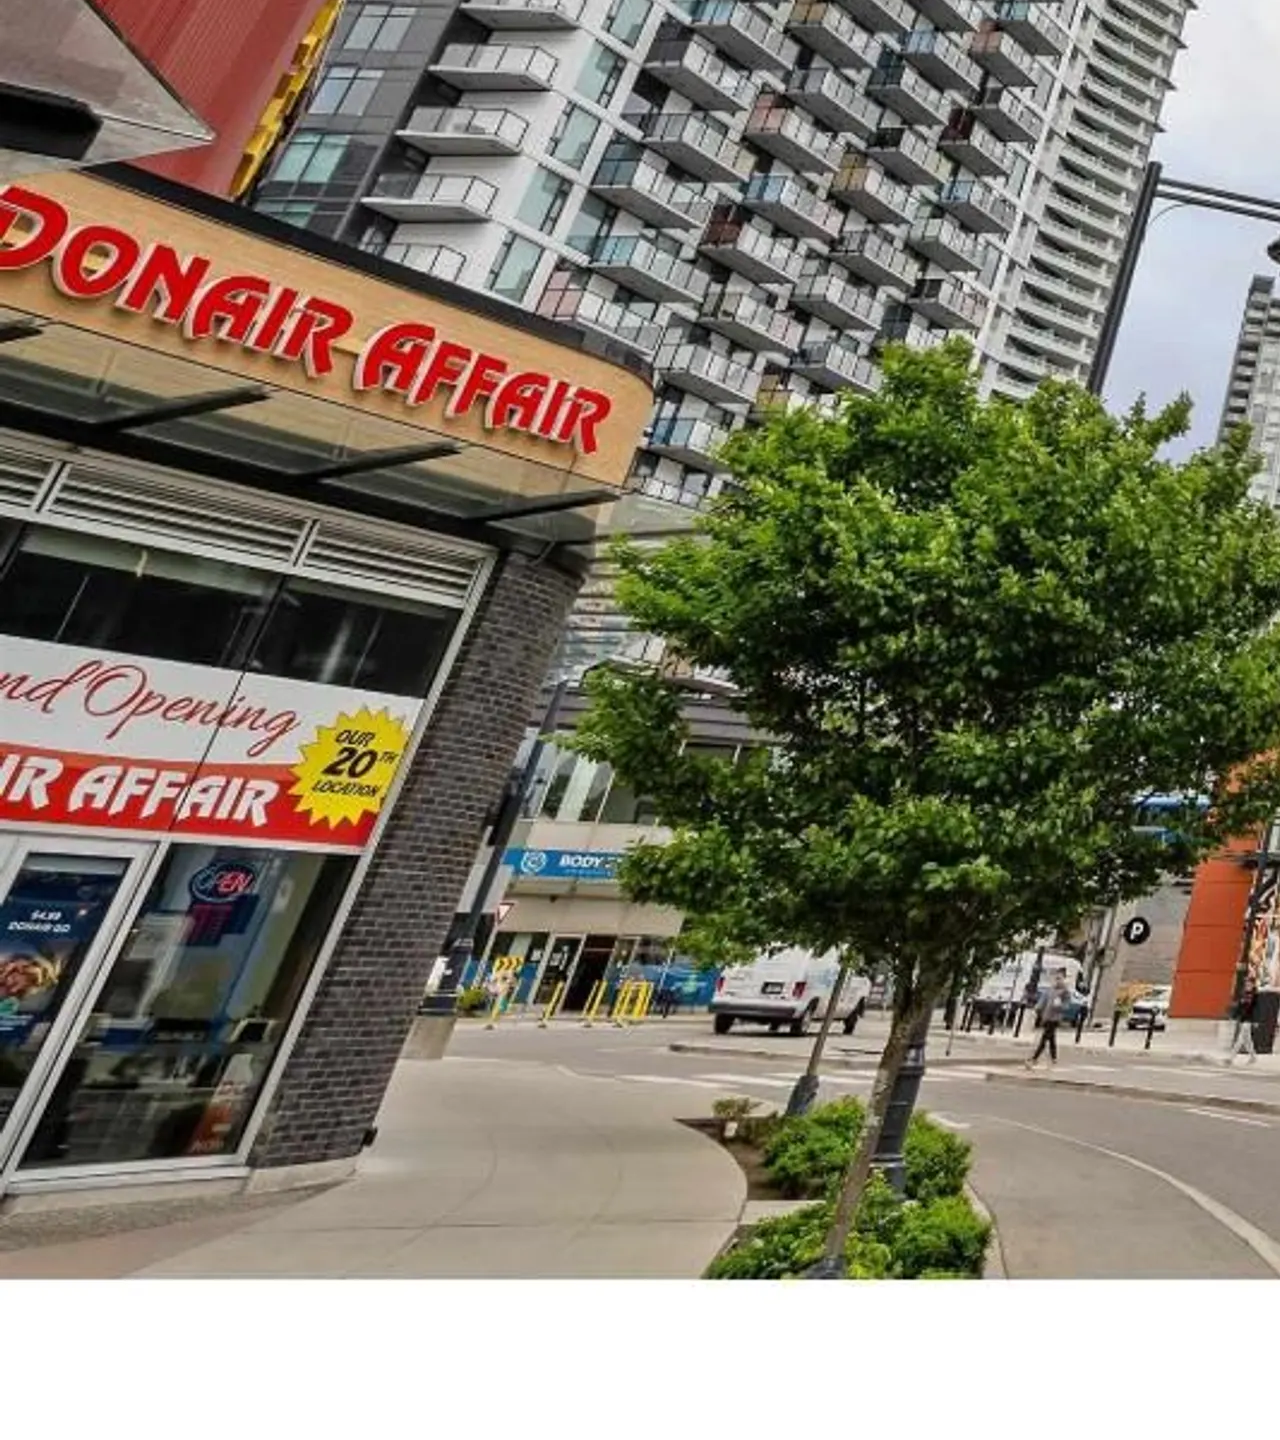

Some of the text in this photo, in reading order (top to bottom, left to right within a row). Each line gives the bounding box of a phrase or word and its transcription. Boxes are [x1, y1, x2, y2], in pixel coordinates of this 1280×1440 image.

[0, 185, 611, 455] DONAIR AFFAIR
[84, 664, 300, 757] Opening
[335, 729, 376, 747] OUR
[68, 765, 280, 827] AFFAIR
[311, 780, 382, 797] LOCATION
[558, 854, 602, 869] BODY
[1129, 923, 1145, 940] P
